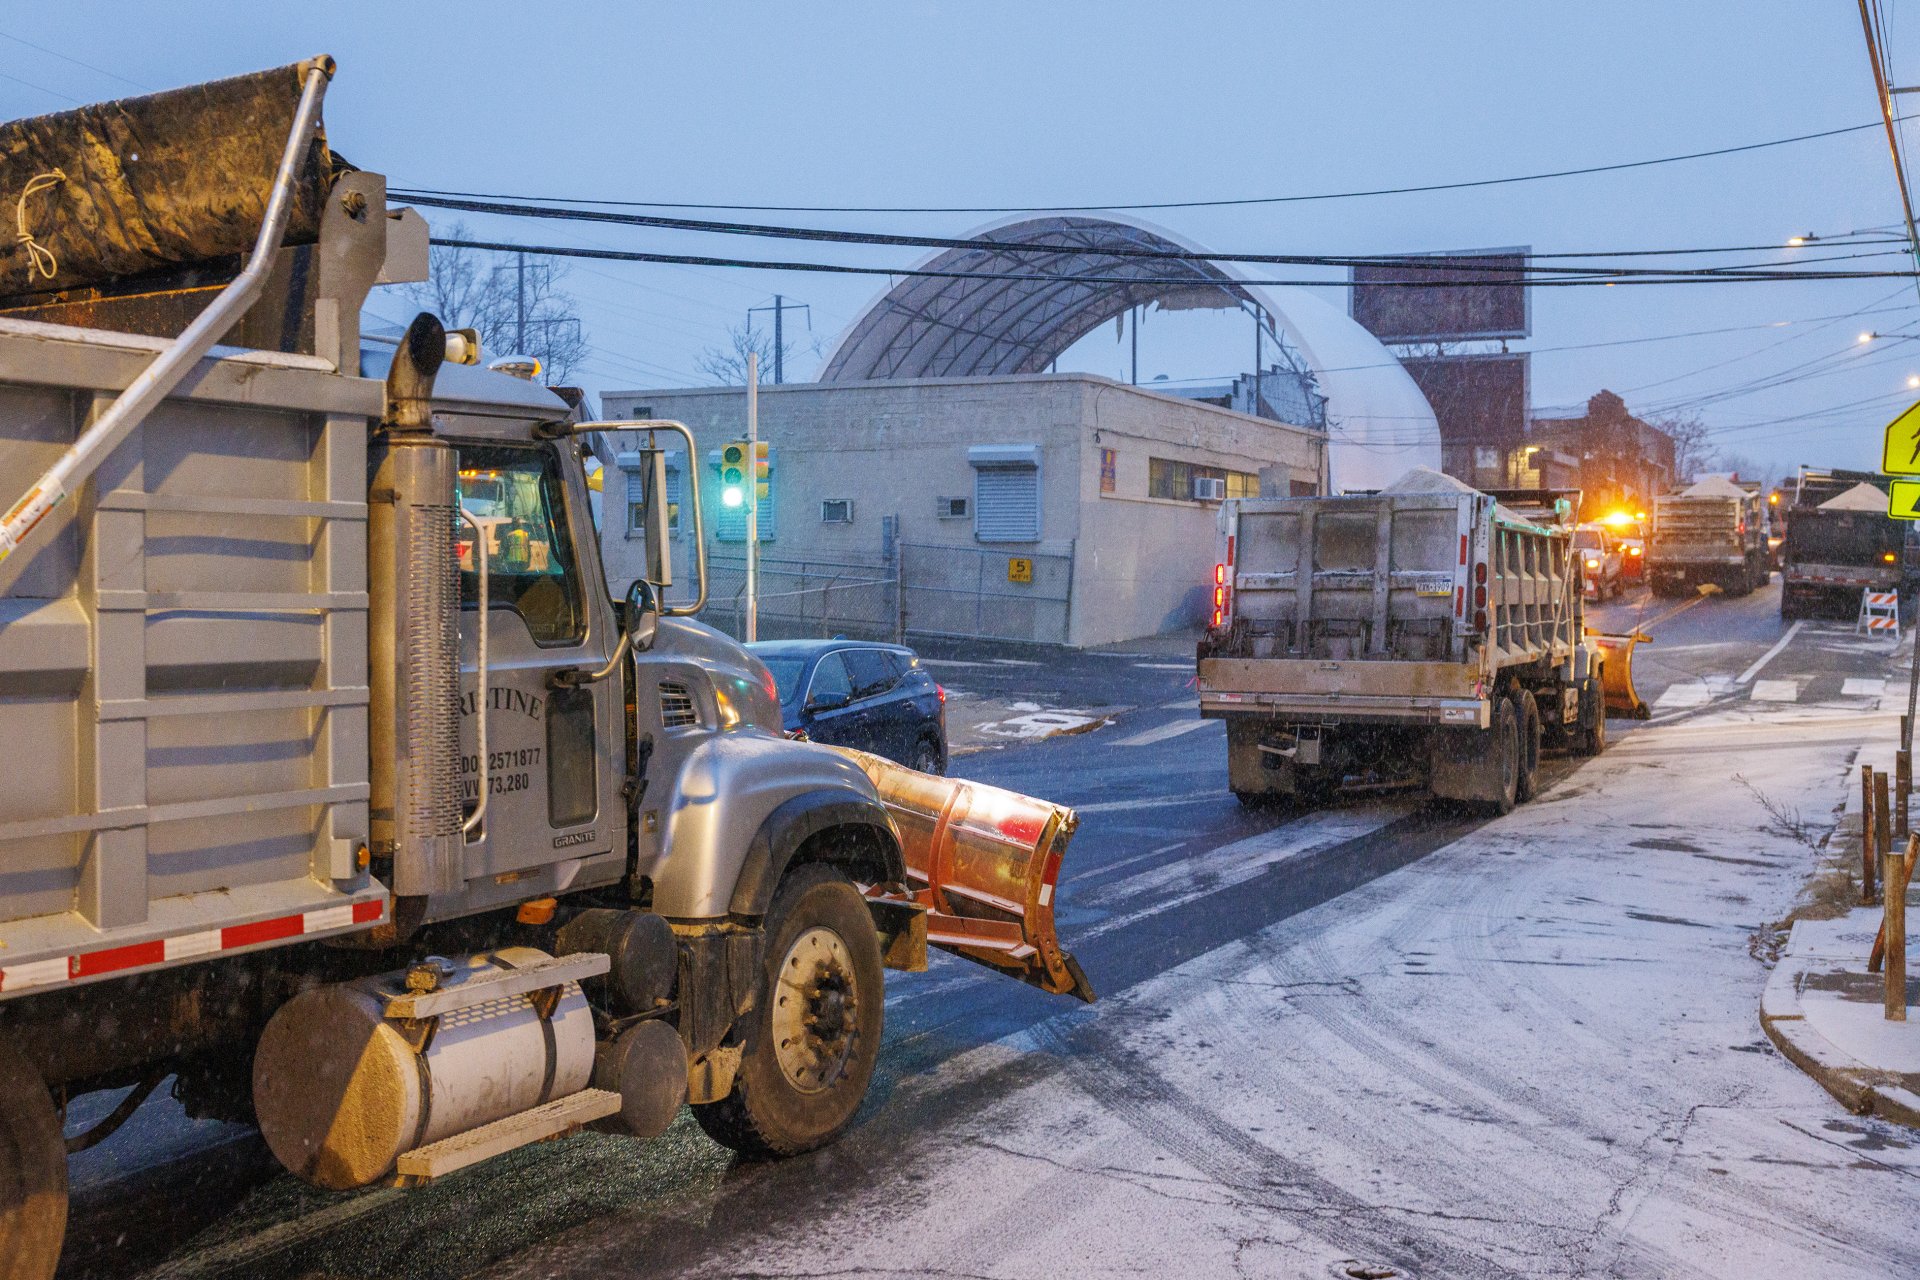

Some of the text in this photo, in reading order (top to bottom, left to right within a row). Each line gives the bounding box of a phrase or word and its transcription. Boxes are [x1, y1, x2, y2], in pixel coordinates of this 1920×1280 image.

[1016, 560, 1026, 573] 5
[489, 748, 541, 770] 2571877
[488, 773, 529, 795] 73,280
[554, 831, 596, 848] GRANITE
